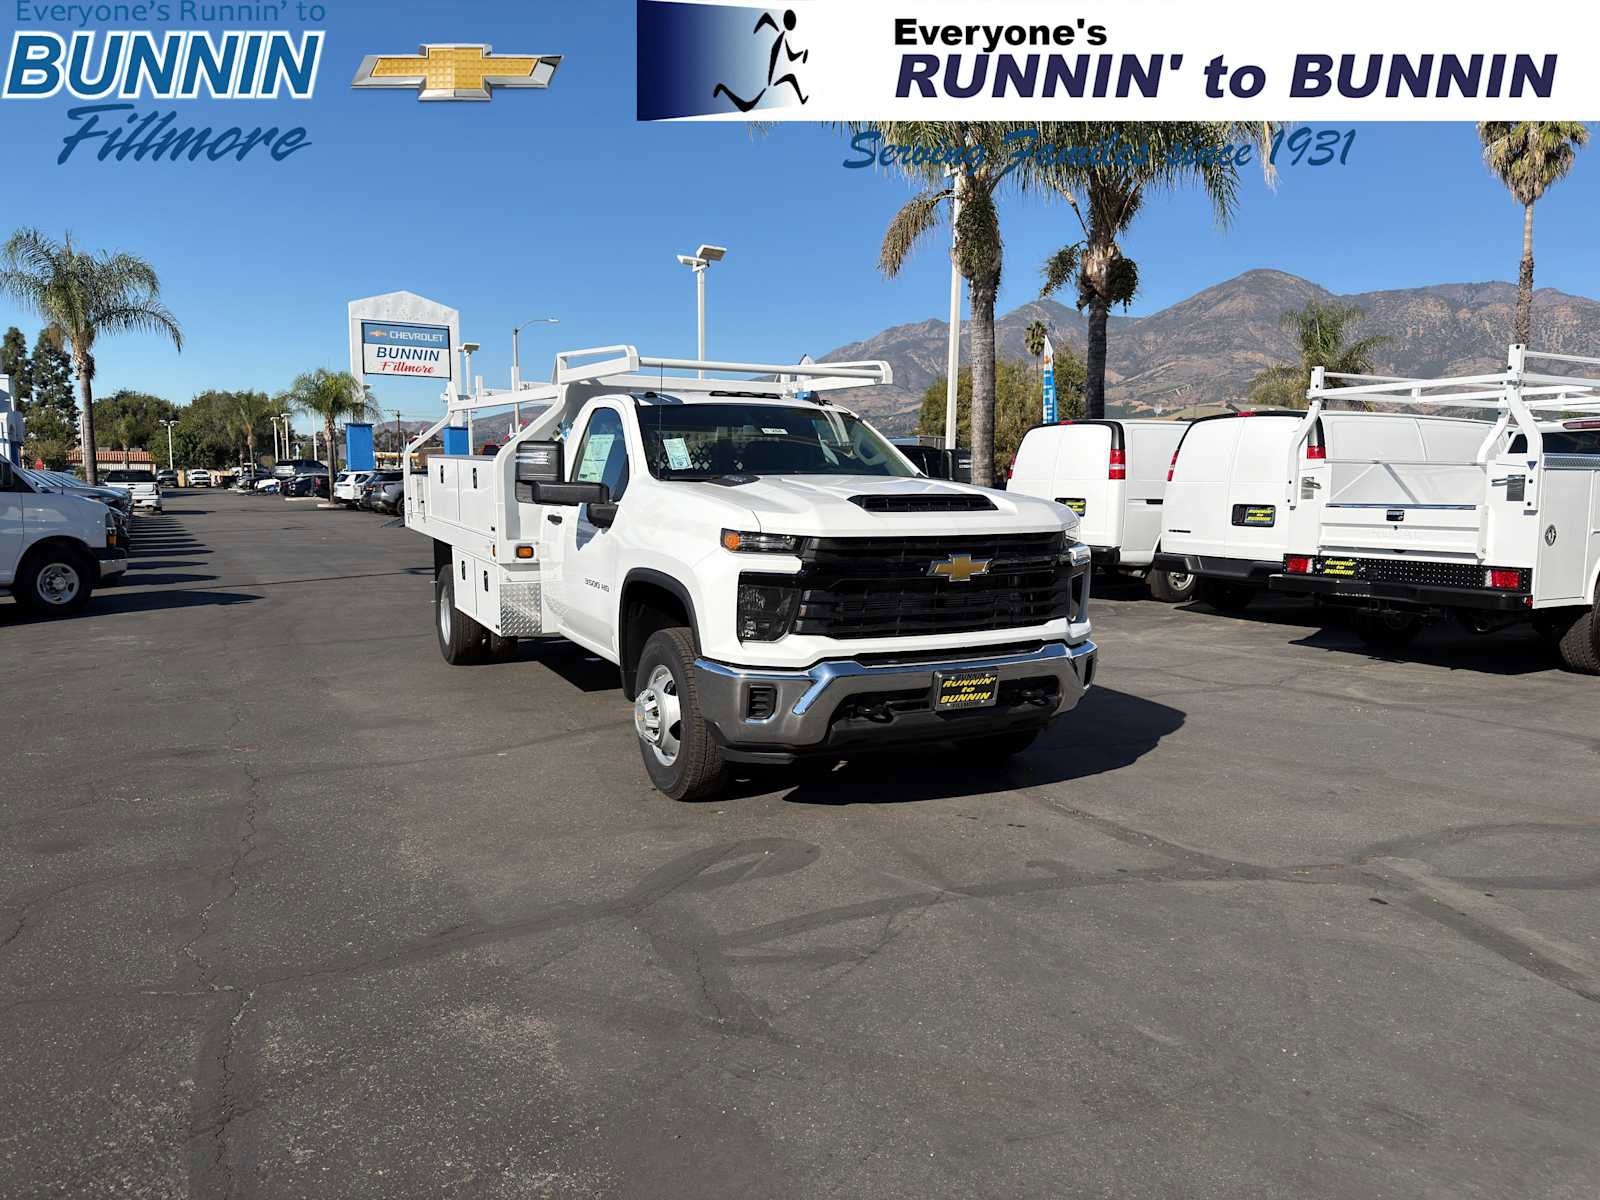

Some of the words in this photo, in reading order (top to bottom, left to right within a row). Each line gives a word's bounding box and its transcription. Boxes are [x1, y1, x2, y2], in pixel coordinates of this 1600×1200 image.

[390, 330, 444, 342] CHEVROLET
[376, 347, 440, 361] BUNNIN
[380, 360, 434, 374] Fillmore
[940, 692, 991, 704] BUNNIN
